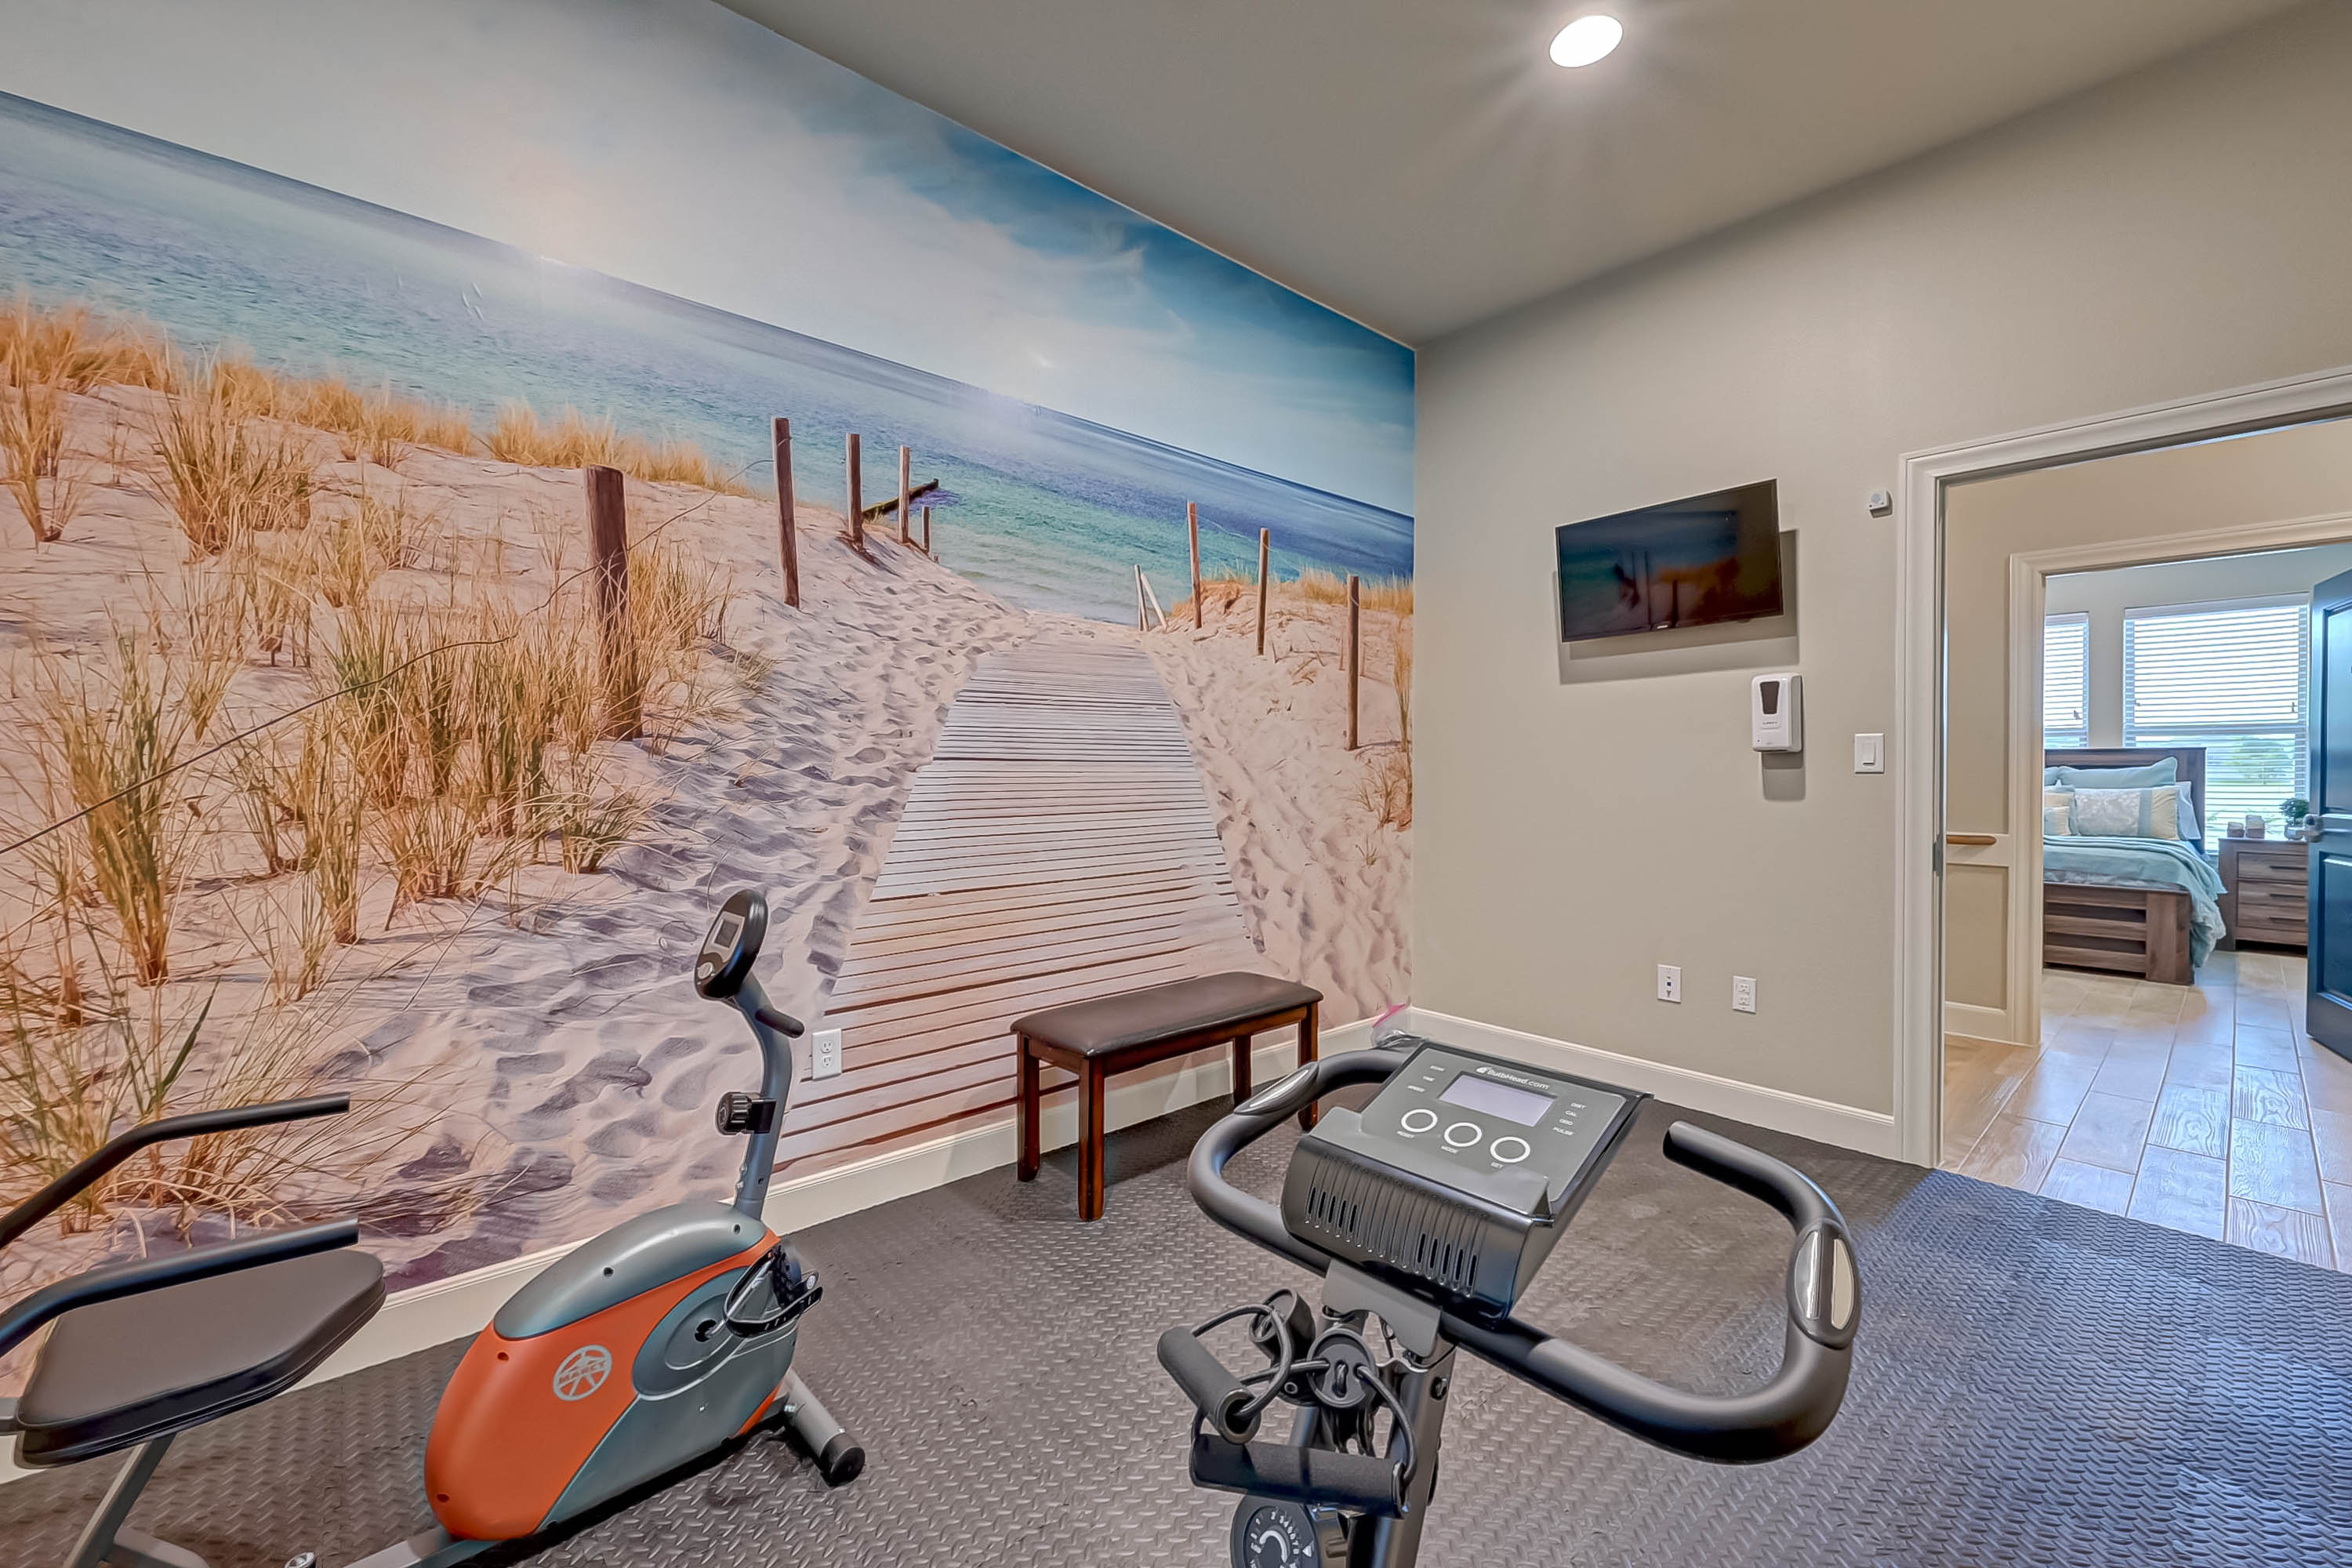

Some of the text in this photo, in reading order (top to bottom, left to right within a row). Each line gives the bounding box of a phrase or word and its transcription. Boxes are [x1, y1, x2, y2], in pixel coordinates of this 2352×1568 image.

[1487, 1069, 1549, 1090] BulbHead.com
[1553, 1127, 1573, 1135] PULSE
[558, 1360, 605, 1386] MARCY
